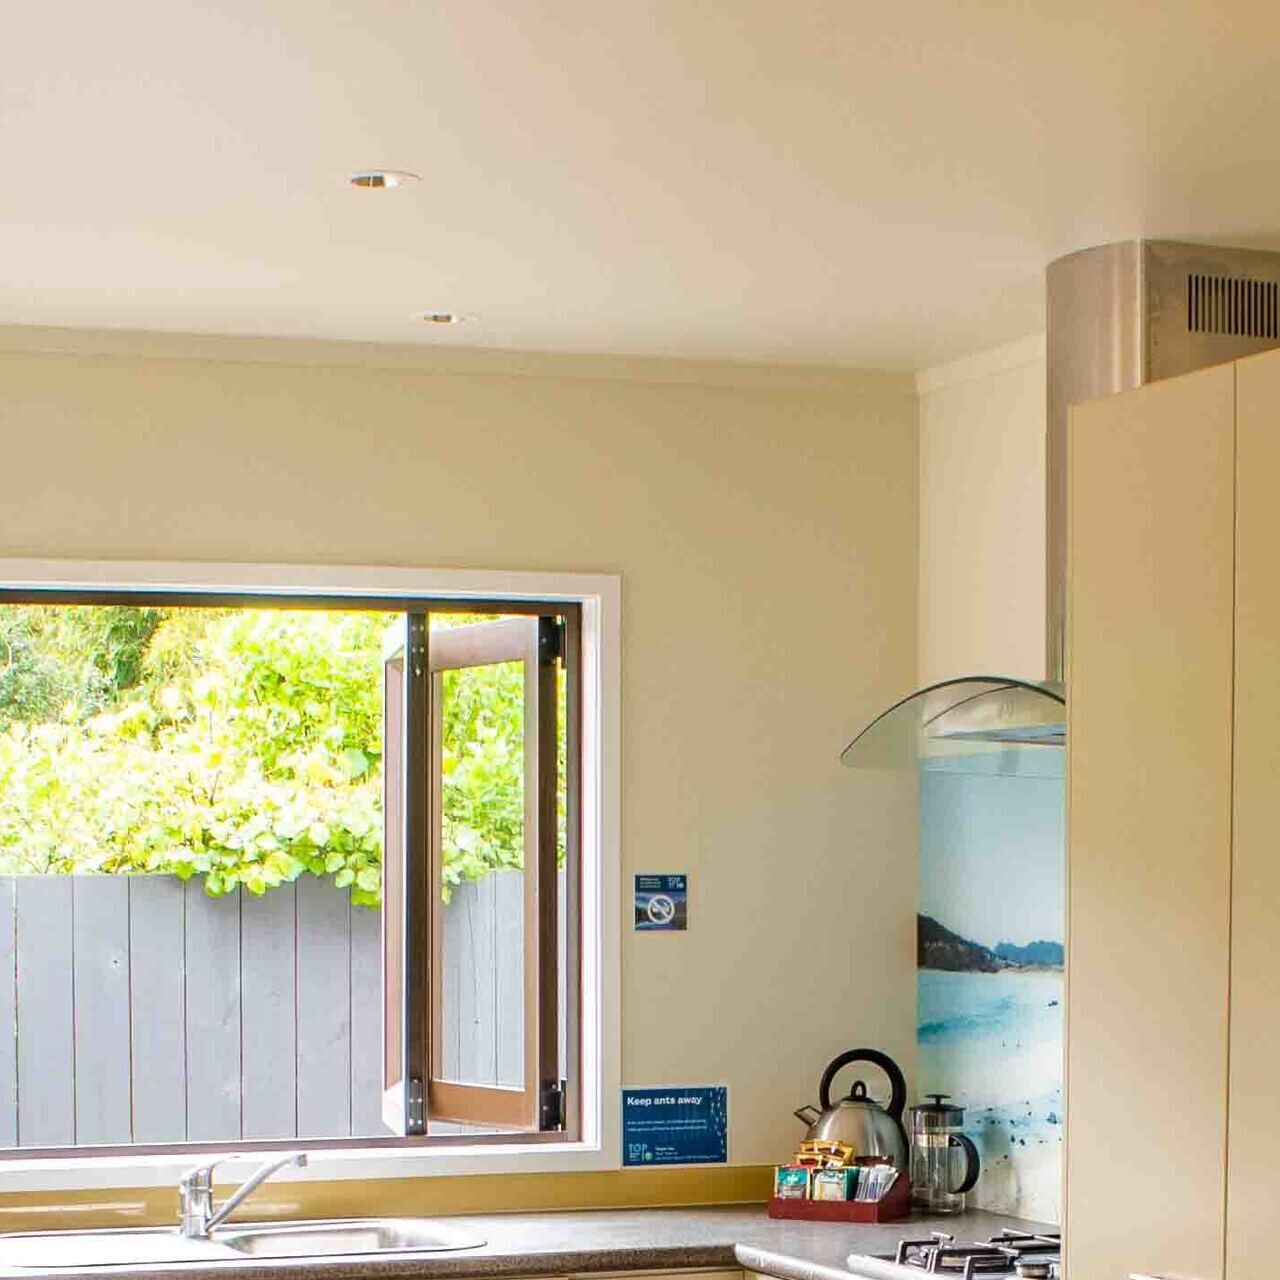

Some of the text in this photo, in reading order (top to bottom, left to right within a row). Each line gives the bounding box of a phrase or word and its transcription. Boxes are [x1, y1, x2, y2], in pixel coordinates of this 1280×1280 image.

[627, 1096, 702, 1107] Keep ants away
